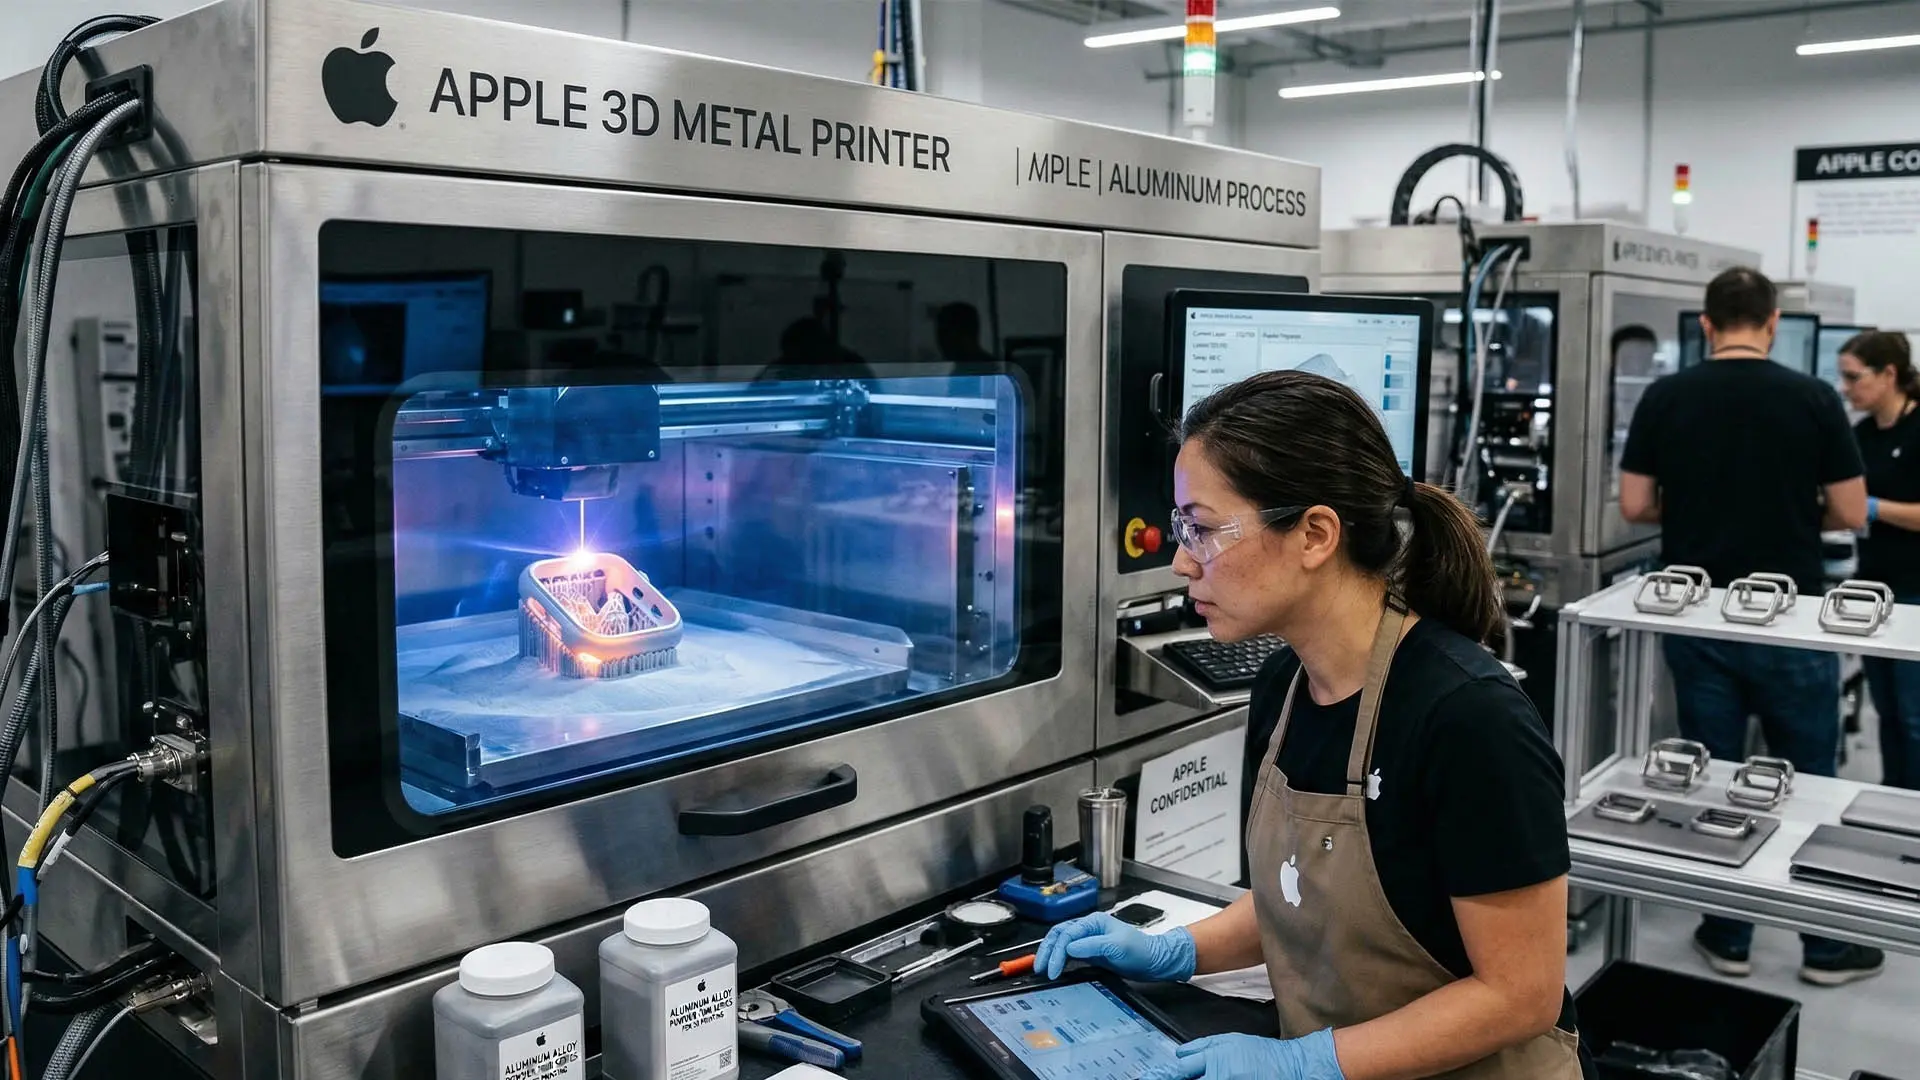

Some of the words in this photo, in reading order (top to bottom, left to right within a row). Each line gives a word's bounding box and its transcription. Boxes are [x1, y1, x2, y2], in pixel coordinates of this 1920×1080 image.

[429, 67, 588, 130] APPLE
[601, 89, 660, 137] 3D
[673, 99, 802, 155] METAL
[812, 117, 951, 173] PRINTER
[1816, 150, 1885, 174] APPLE
[1108, 163, 1222, 206] ALUMINUM
[1226, 180, 1307, 217] PROCESS
[1172, 756, 1207, 783] APPLE
[1150, 771, 1228, 814] CONFIDENTIAL
[711, 988, 733, 1003] ALLOY
[505, 1051, 551, 1075] ALUMINUM
[552, 1040, 578, 1058] ALLOY
